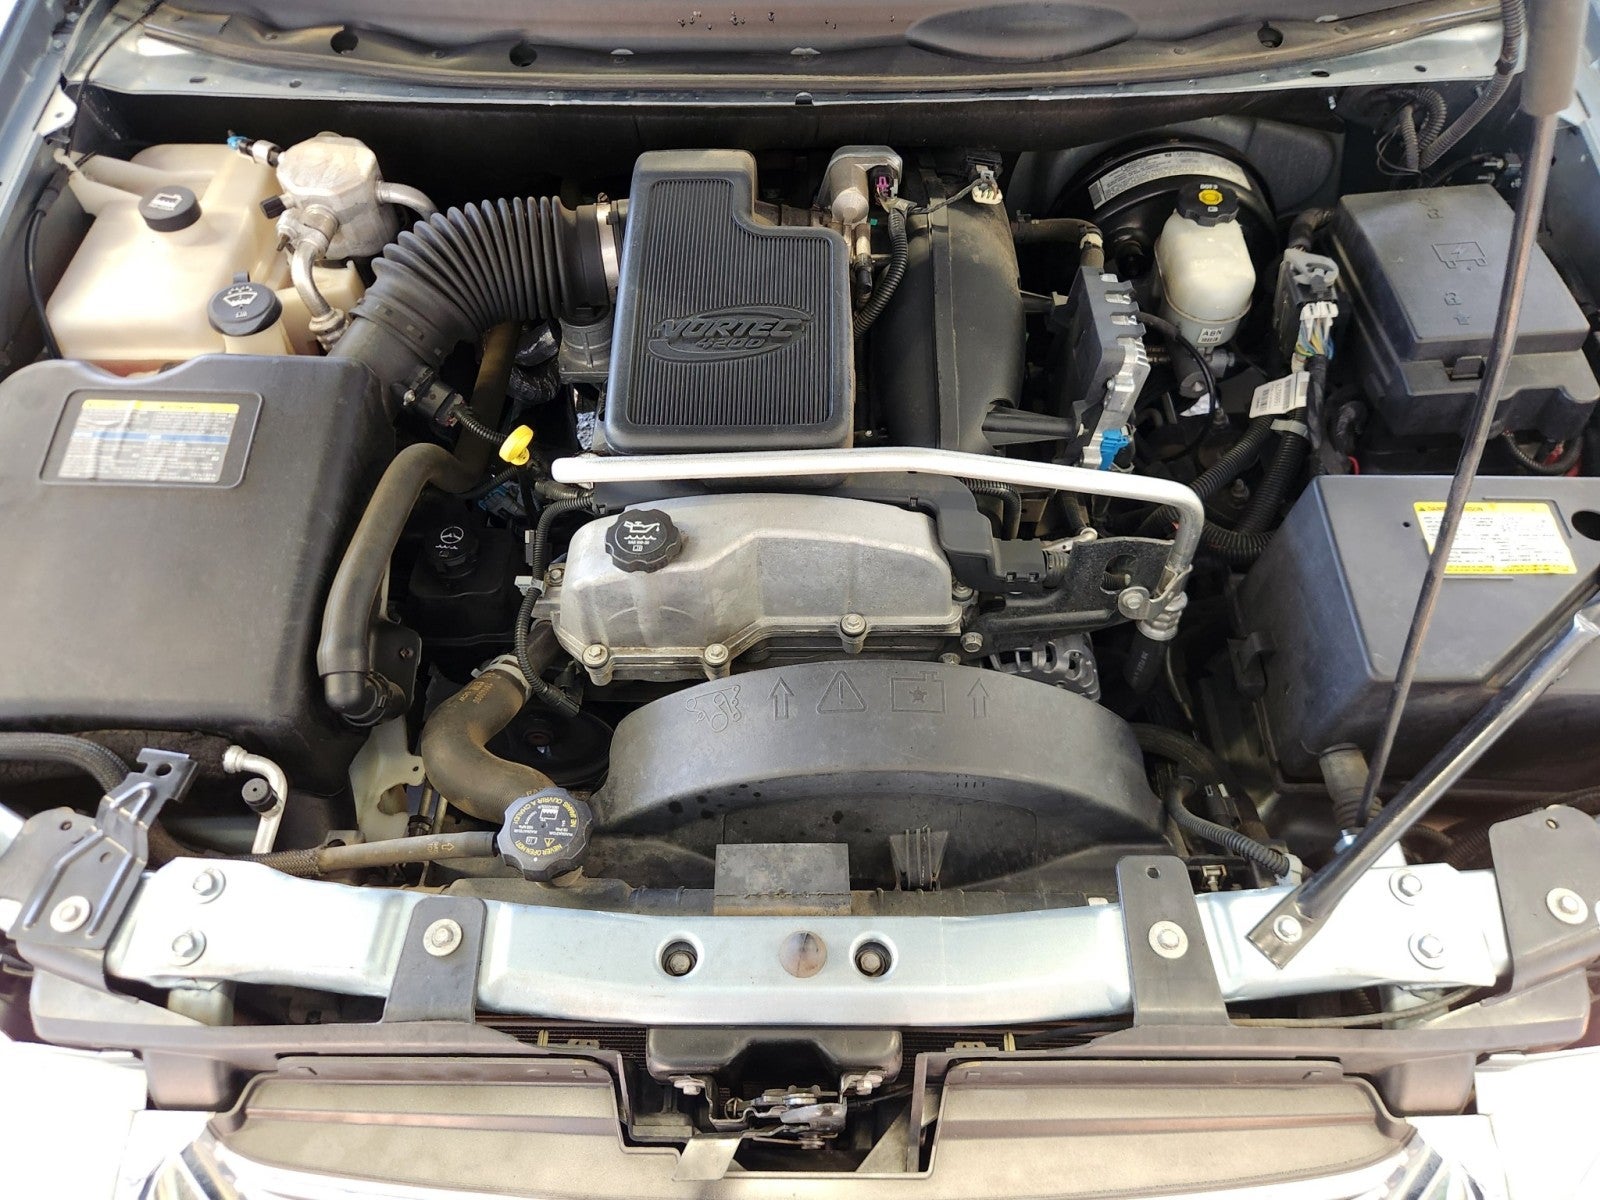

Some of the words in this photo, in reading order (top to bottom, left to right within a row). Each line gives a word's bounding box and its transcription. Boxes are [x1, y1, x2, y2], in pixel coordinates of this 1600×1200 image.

[662, 318, 802, 338] VORTEC
[695, 337, 766, 349] 4200
[526, 848, 541, 856] OPEN
[542, 843, 562, 855] NEVER
